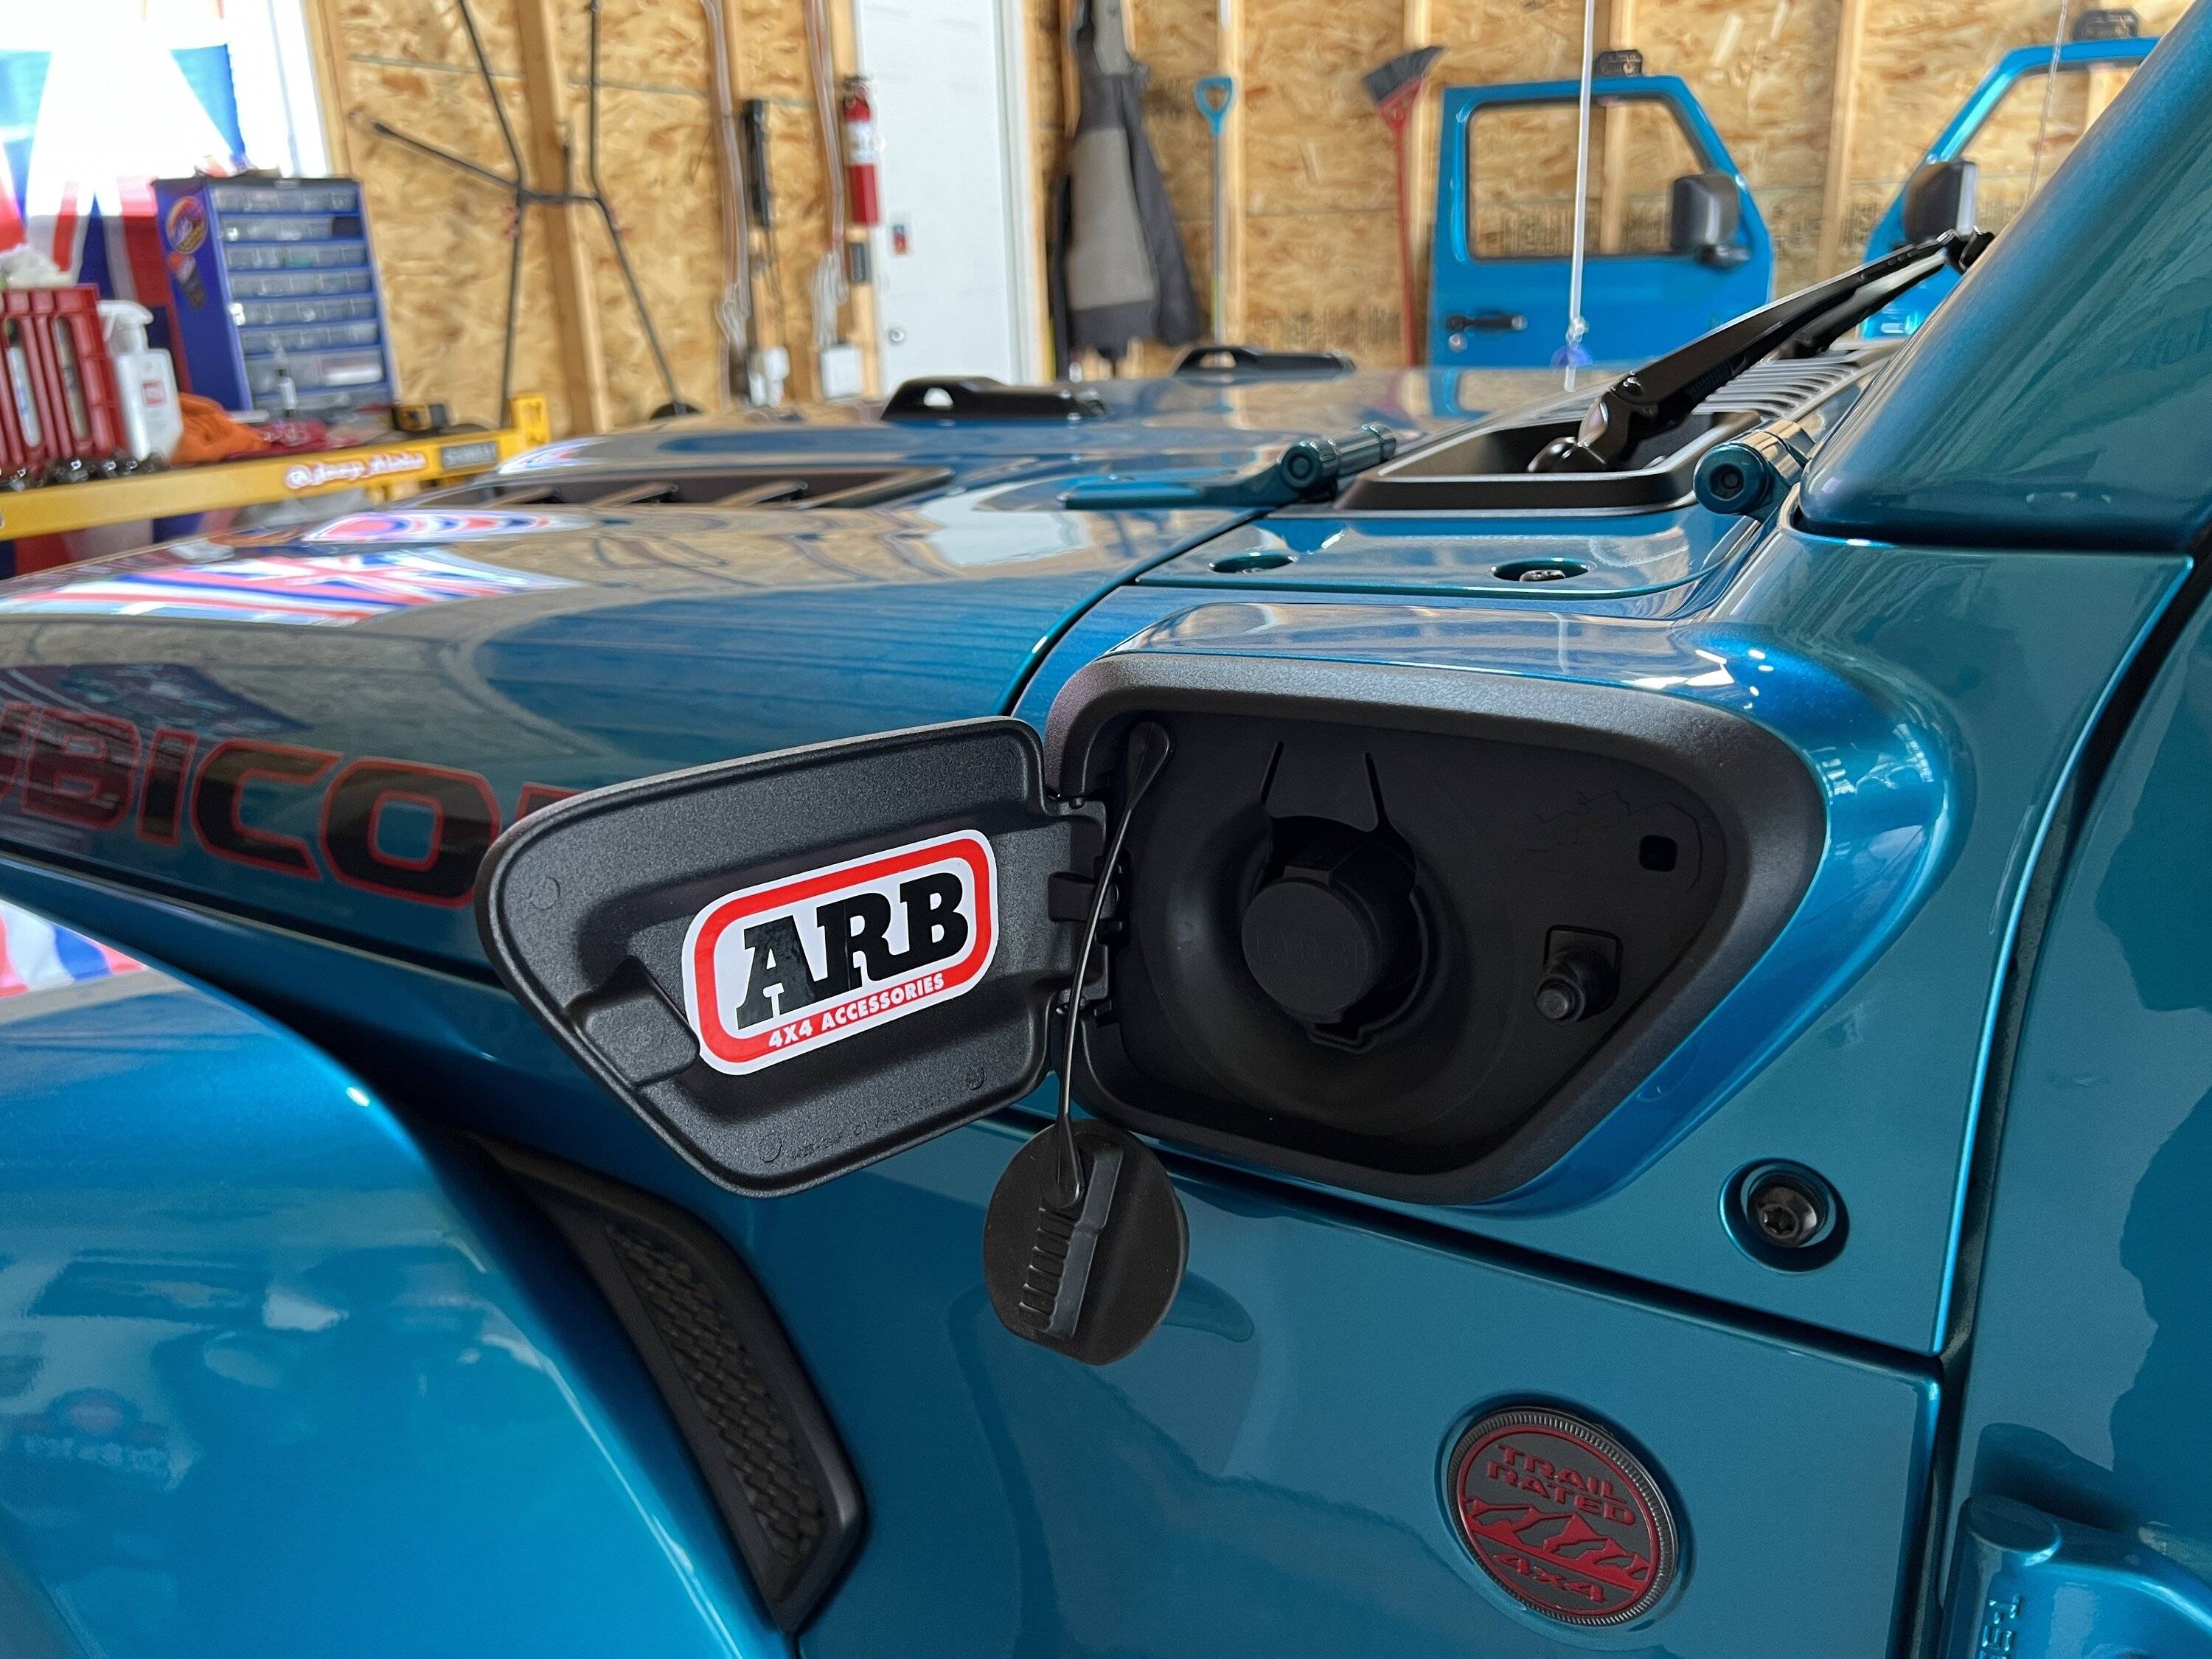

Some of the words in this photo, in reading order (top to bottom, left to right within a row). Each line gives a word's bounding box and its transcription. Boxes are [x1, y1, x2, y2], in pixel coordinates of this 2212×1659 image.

[0, 702, 588, 908] BICO
[737, 872, 969, 1030] ARB
[768, 1020, 813, 1048] 4X4
[821, 973, 945, 1032] ACCESSORIES
[1486, 1461, 1636, 1526] RATED
[1497, 1444, 1627, 1504] TRAIL
